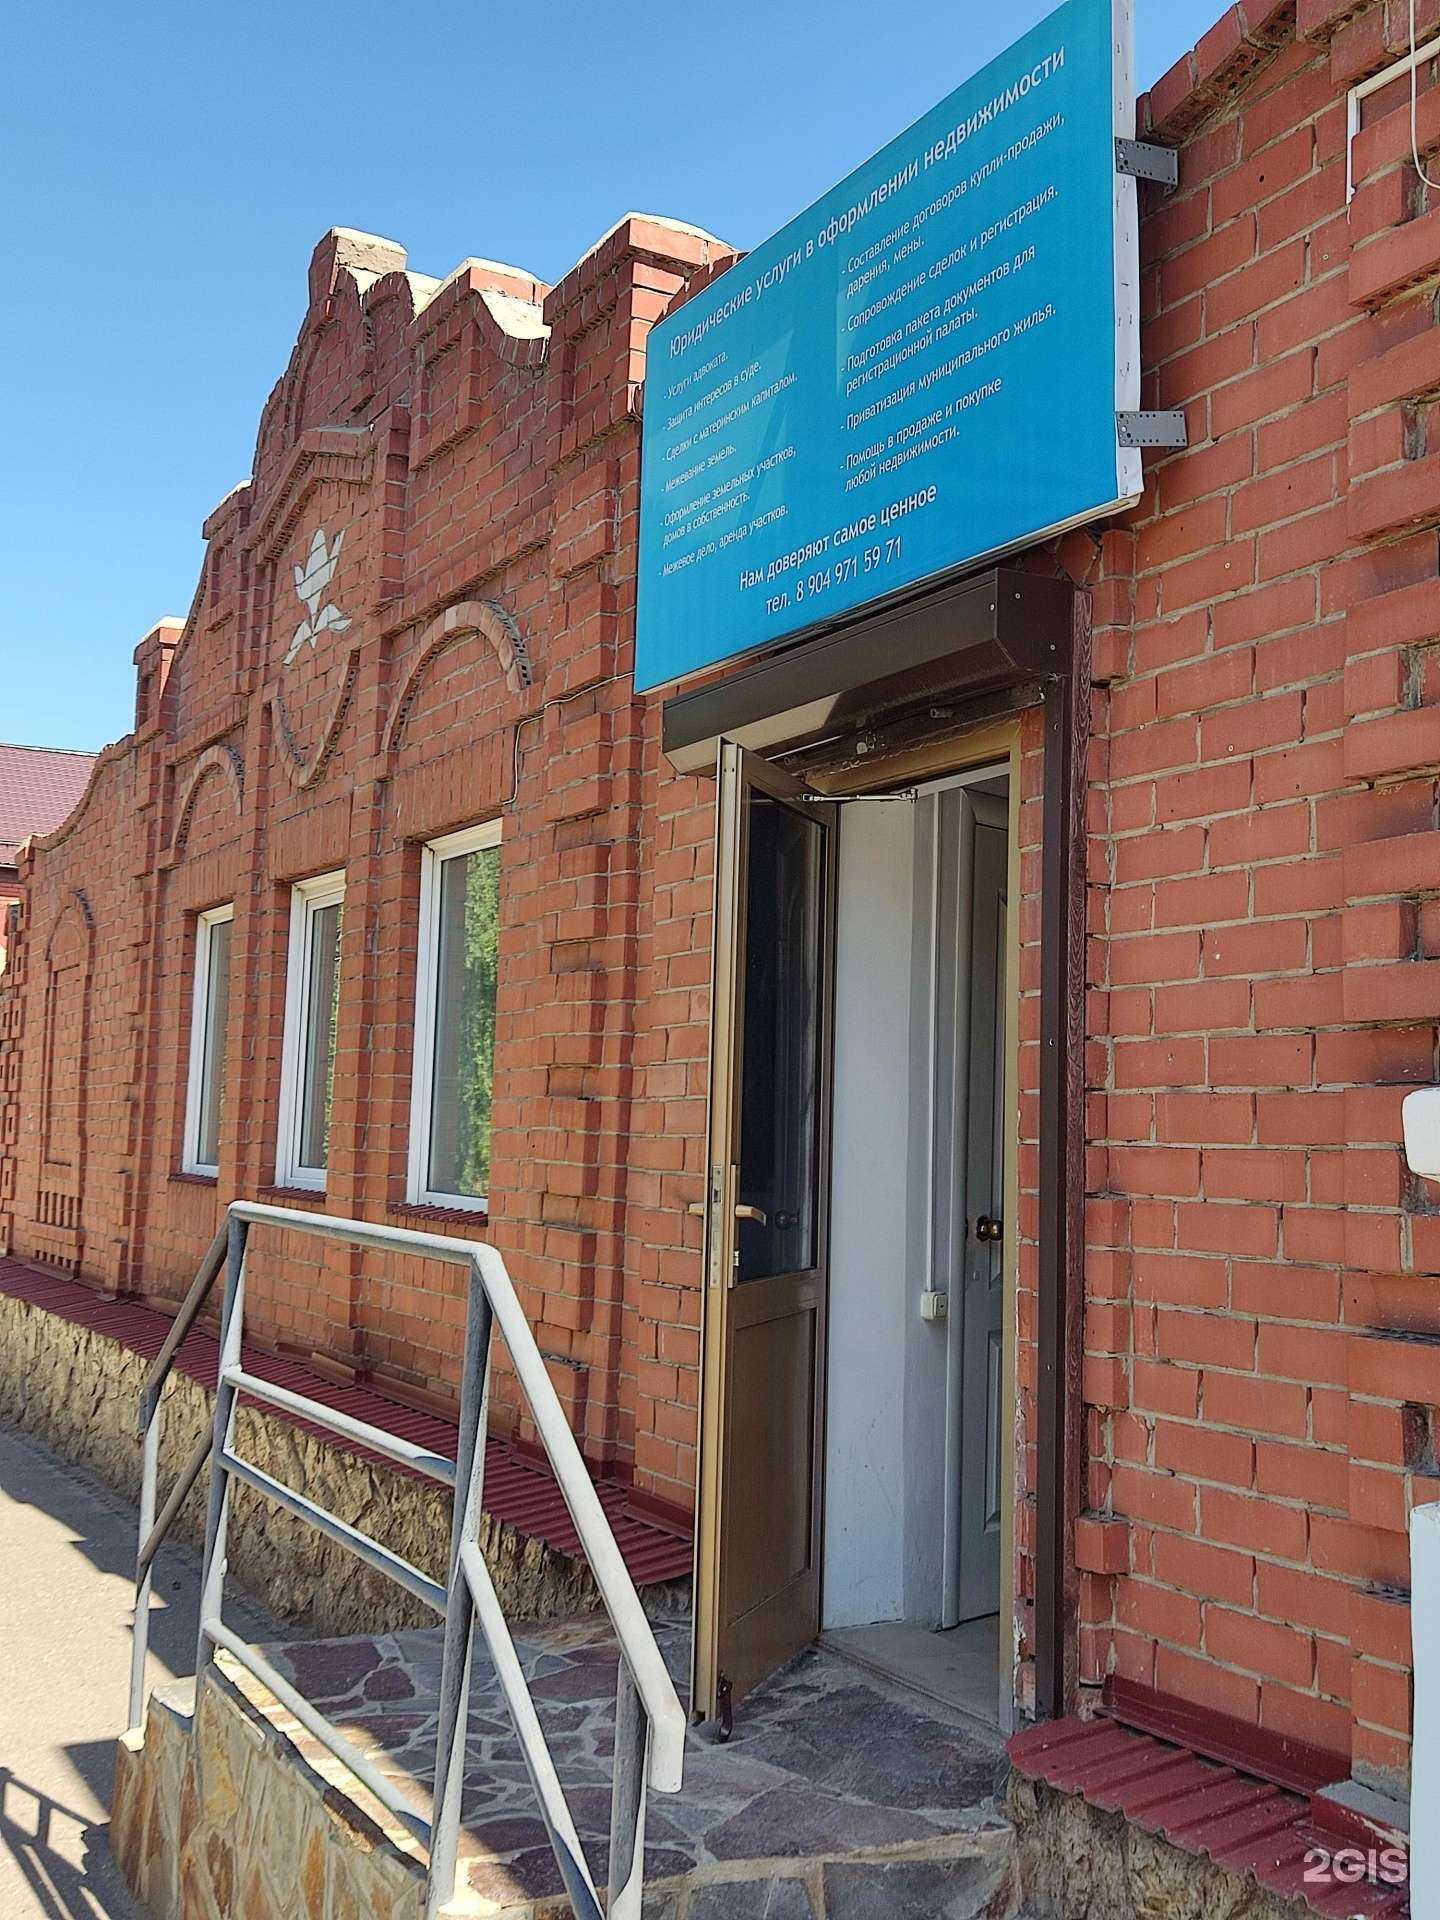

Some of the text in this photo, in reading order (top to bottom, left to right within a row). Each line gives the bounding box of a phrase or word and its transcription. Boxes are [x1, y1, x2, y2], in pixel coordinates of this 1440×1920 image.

[670, 45, 1065, 359] Юридические услуги в оформлении недвижимости
[848, 112, 1065, 273] Составление договоров купли-продажи,
[847, 184, 1058, 331] Сопровождение сделок и регистрация.
[847, 236, 924, 299] дарения, мены.
[847, 245, 1035, 372] Подготовка пакета документов для
[668, 351, 728, 399] Услуги адвоката.
[846, 307, 978, 397] регистрационной палаты.
[847, 303, 1056, 431] Приватизация муниципального жилья.
[666, 361, 762, 431] Защита интересов в суде.
[666, 372, 797, 462] Сделки с материнским капиталом.
[846, 377, 1002, 471] Помощь в продаже и покупке
[664, 445, 796, 527] Оформление земельных участков,
[665, 444, 737, 493] Межевание земель.
[845, 424, 960, 492] любой недвижимости.
[663, 491, 750, 550] домов в собственность.
[663, 504, 788, 577] Межевое дело, аренда участков.
[740, 484, 937, 591] Нам доверяют самое ценное
[766, 535, 901, 615] тел. 8 904 971 59 71
